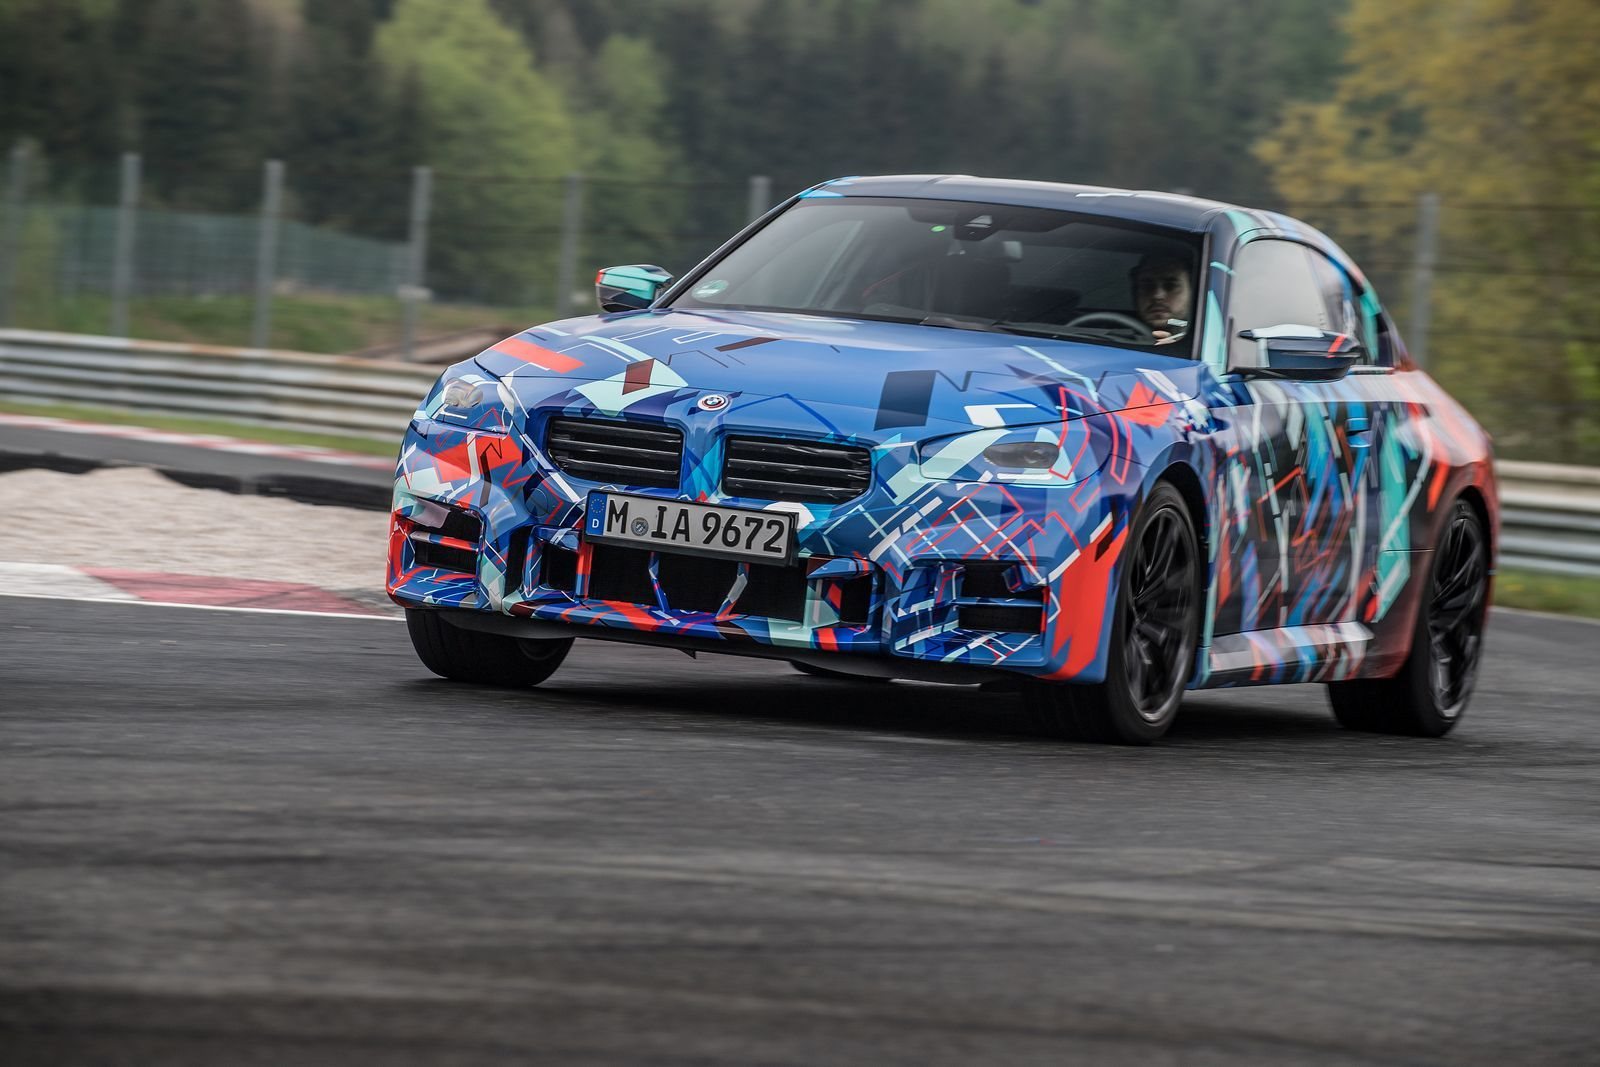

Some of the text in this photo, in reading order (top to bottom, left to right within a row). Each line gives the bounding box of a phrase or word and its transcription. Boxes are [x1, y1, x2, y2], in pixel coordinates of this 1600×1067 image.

[592, 518, 600, 528] D
[606, 499, 629, 534] M
[651, 505, 690, 542] IA
[702, 512, 785, 553] 9672
